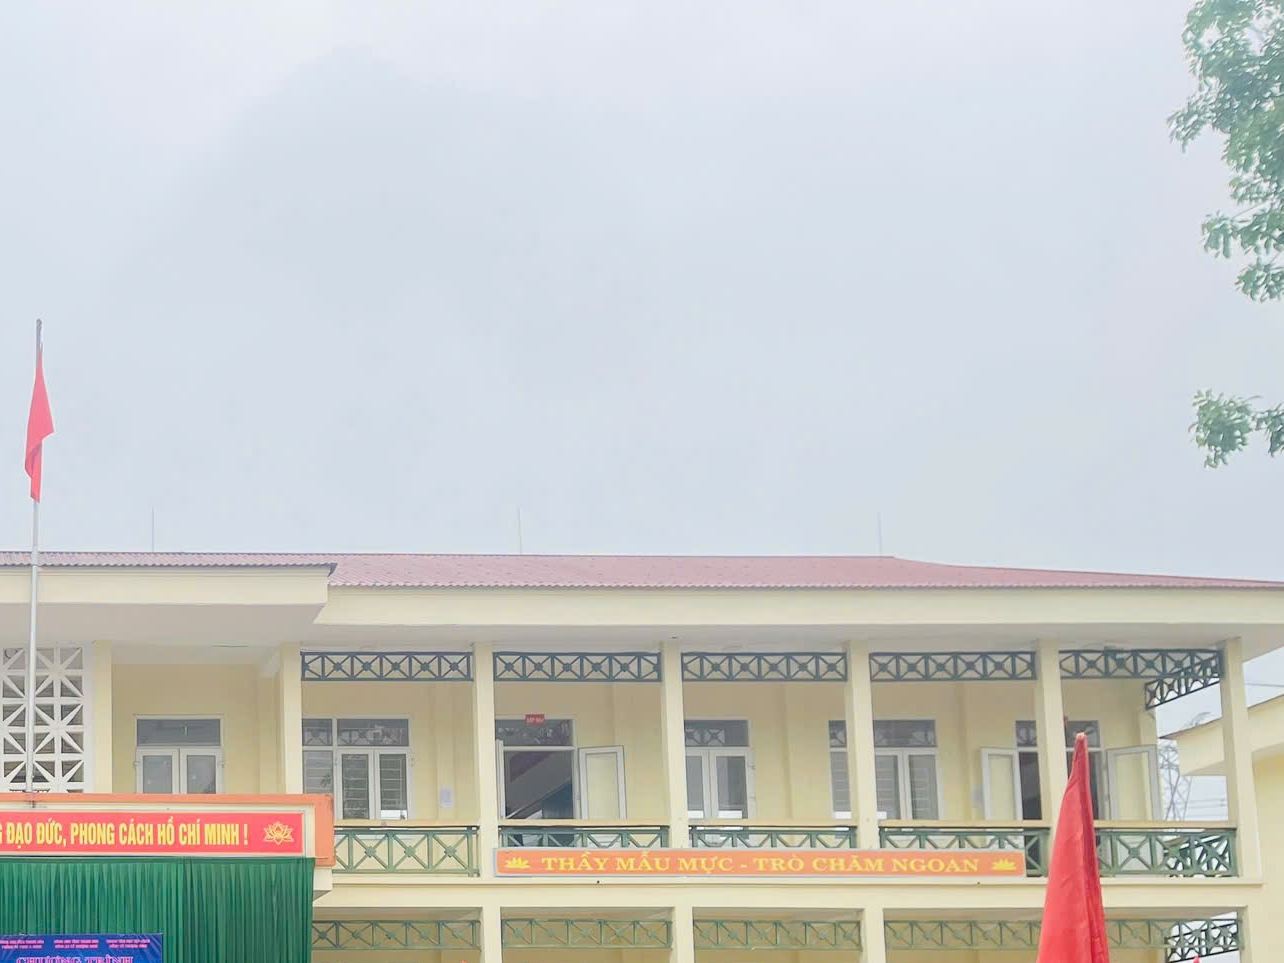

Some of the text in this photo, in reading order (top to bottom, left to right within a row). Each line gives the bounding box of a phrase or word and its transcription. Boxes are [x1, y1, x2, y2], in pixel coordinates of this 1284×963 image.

[6, 821, 33, 849] ĐẠO
[35, 818, 67, 848] ĐỨC,
[70, 822, 115, 846] PHONG
[119, 818, 154, 846] CÁCH
[157, 816, 175, 846] HỒ
[179, 818, 200, 846] CHÍ
[204, 823, 240, 846] MINH
[243, 823, 248, 846] !
[542, 851, 609, 871] THẦY
[616, 851, 670, 871] MẪU
[678, 855, 733, 874] MỰC
[753, 854, 805, 872] TRÒ
[812, 854, 884, 872] CHĂM
[892, 857, 979, 873] NGOAN
